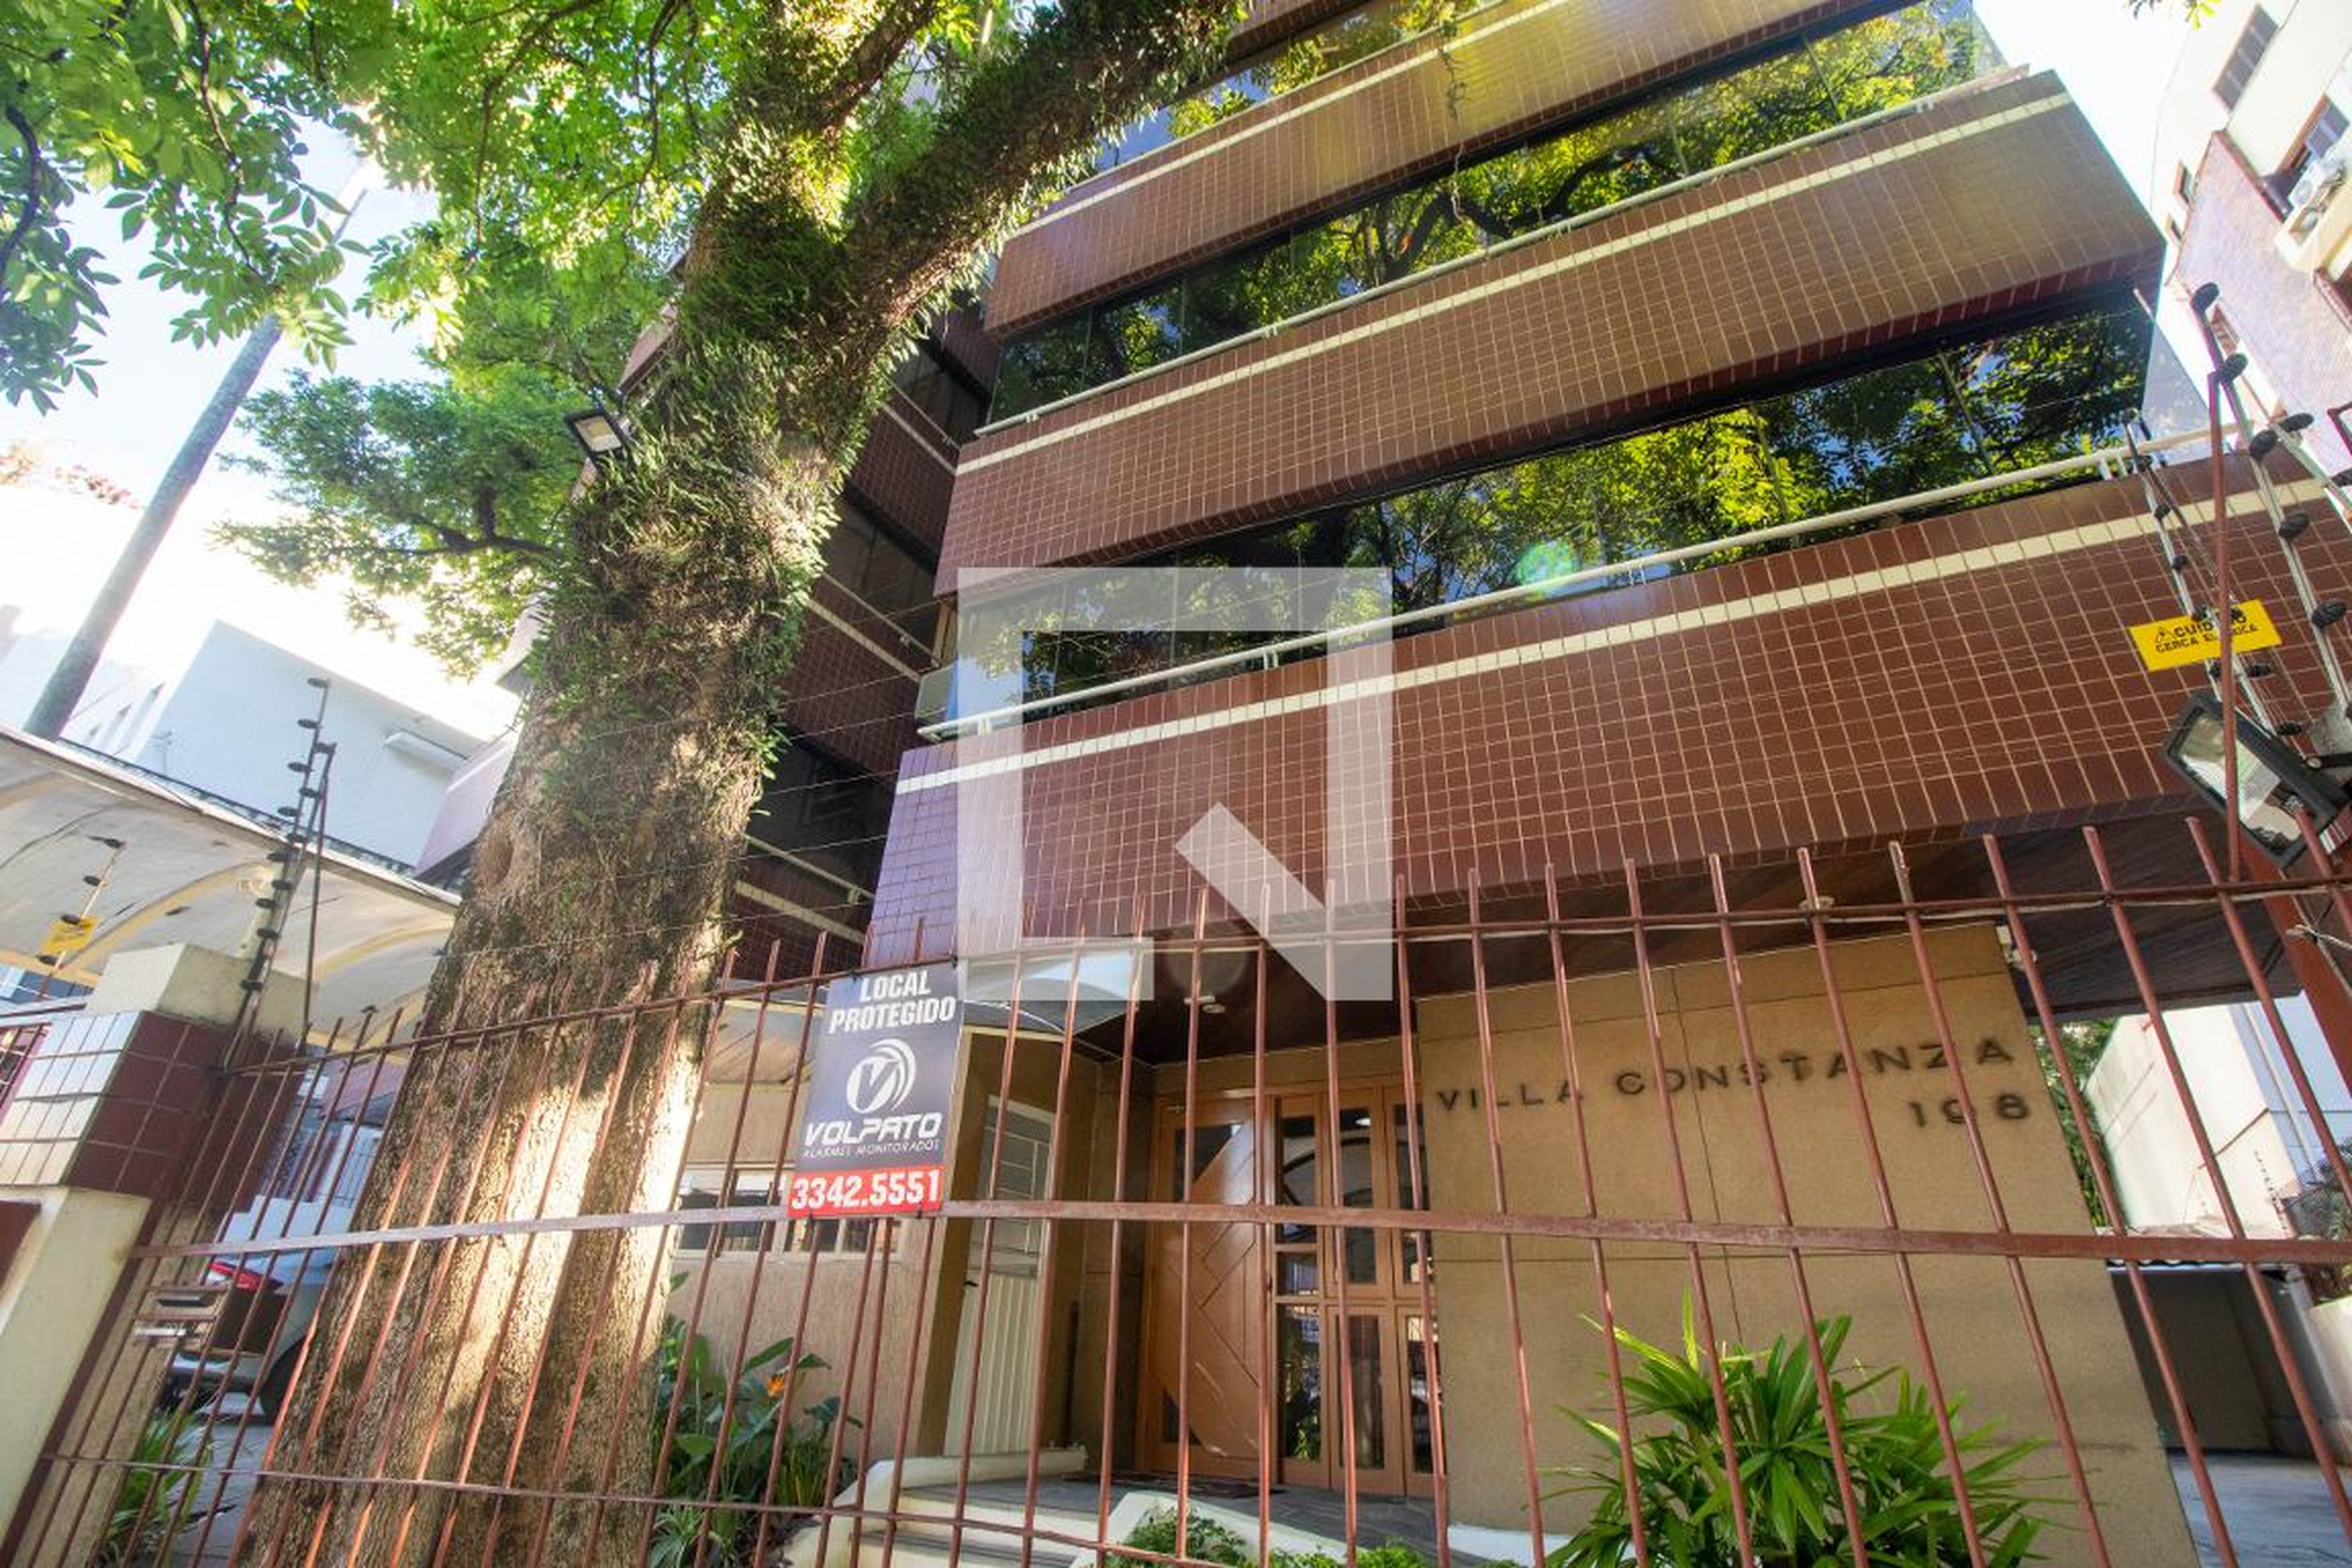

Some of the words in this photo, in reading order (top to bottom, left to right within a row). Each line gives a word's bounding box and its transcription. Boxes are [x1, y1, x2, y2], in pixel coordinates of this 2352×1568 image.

[2174, 613, 2247, 637] CUIDO
[2155, 637, 2199, 654] CERCA
[859, 970, 931, 1003] LOCAL
[828, 996, 957, 1035] PROTEGIDO
[1616, 1038, 2013, 1096] CONSTANZA
[804, 1112, 943, 1147] VOLPATO
[791, 1168, 941, 1210] 3342.5551
